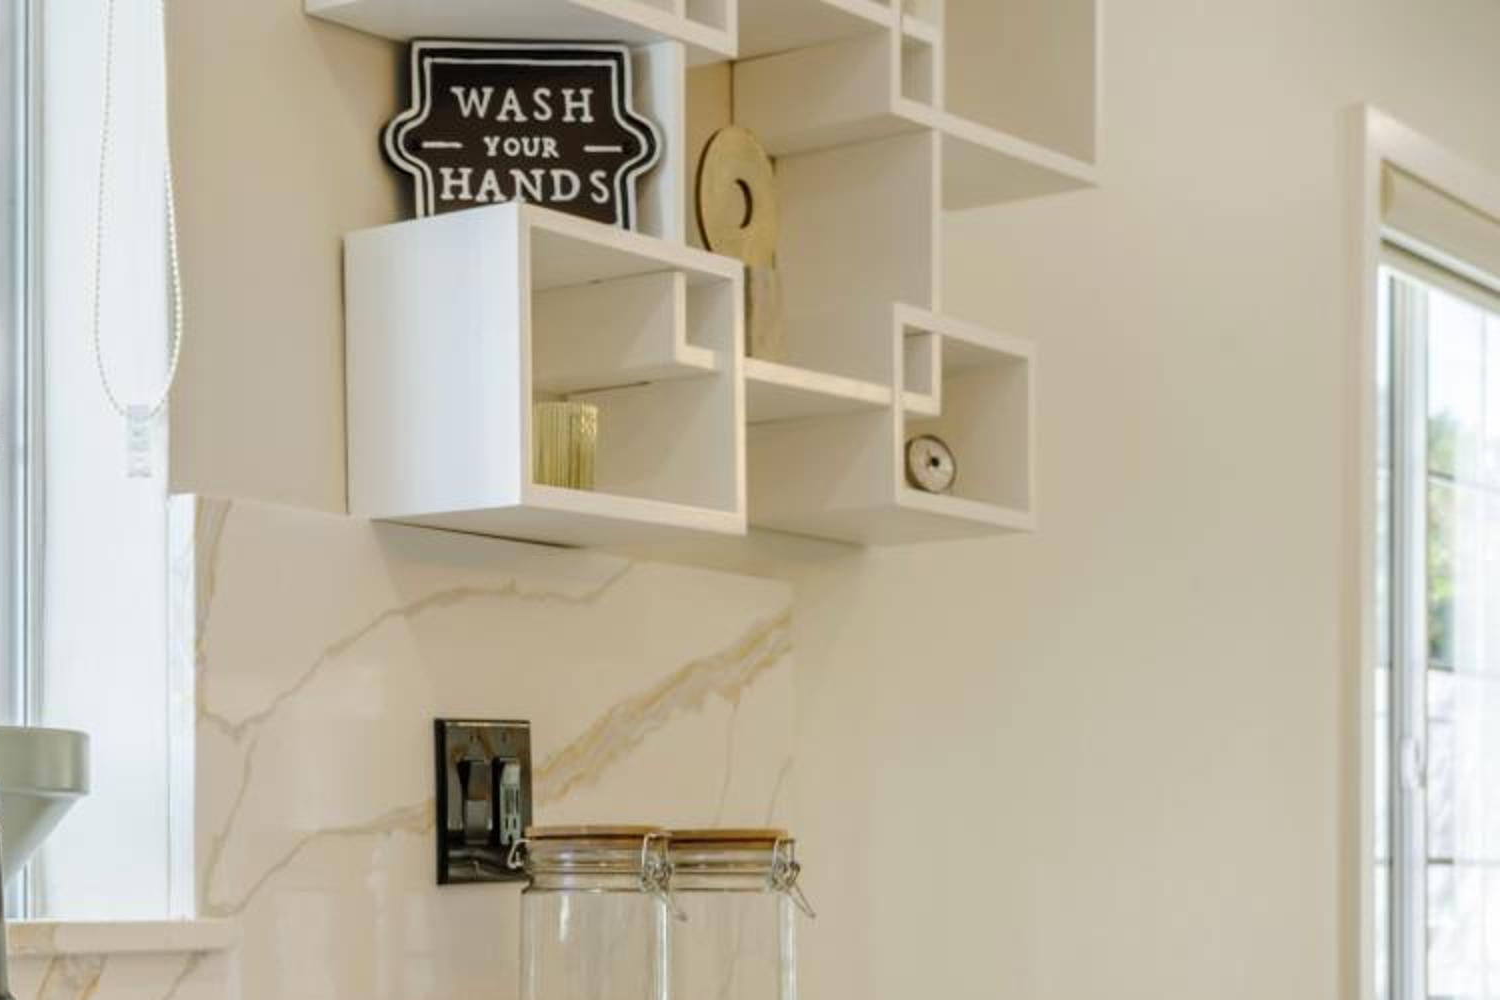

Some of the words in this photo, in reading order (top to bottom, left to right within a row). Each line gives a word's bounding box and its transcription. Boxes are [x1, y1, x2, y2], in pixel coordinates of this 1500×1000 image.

[449, 86, 595, 123] WASH
[483, 136, 560, 158] YOUR
[439, 167, 611, 205] HANDS
